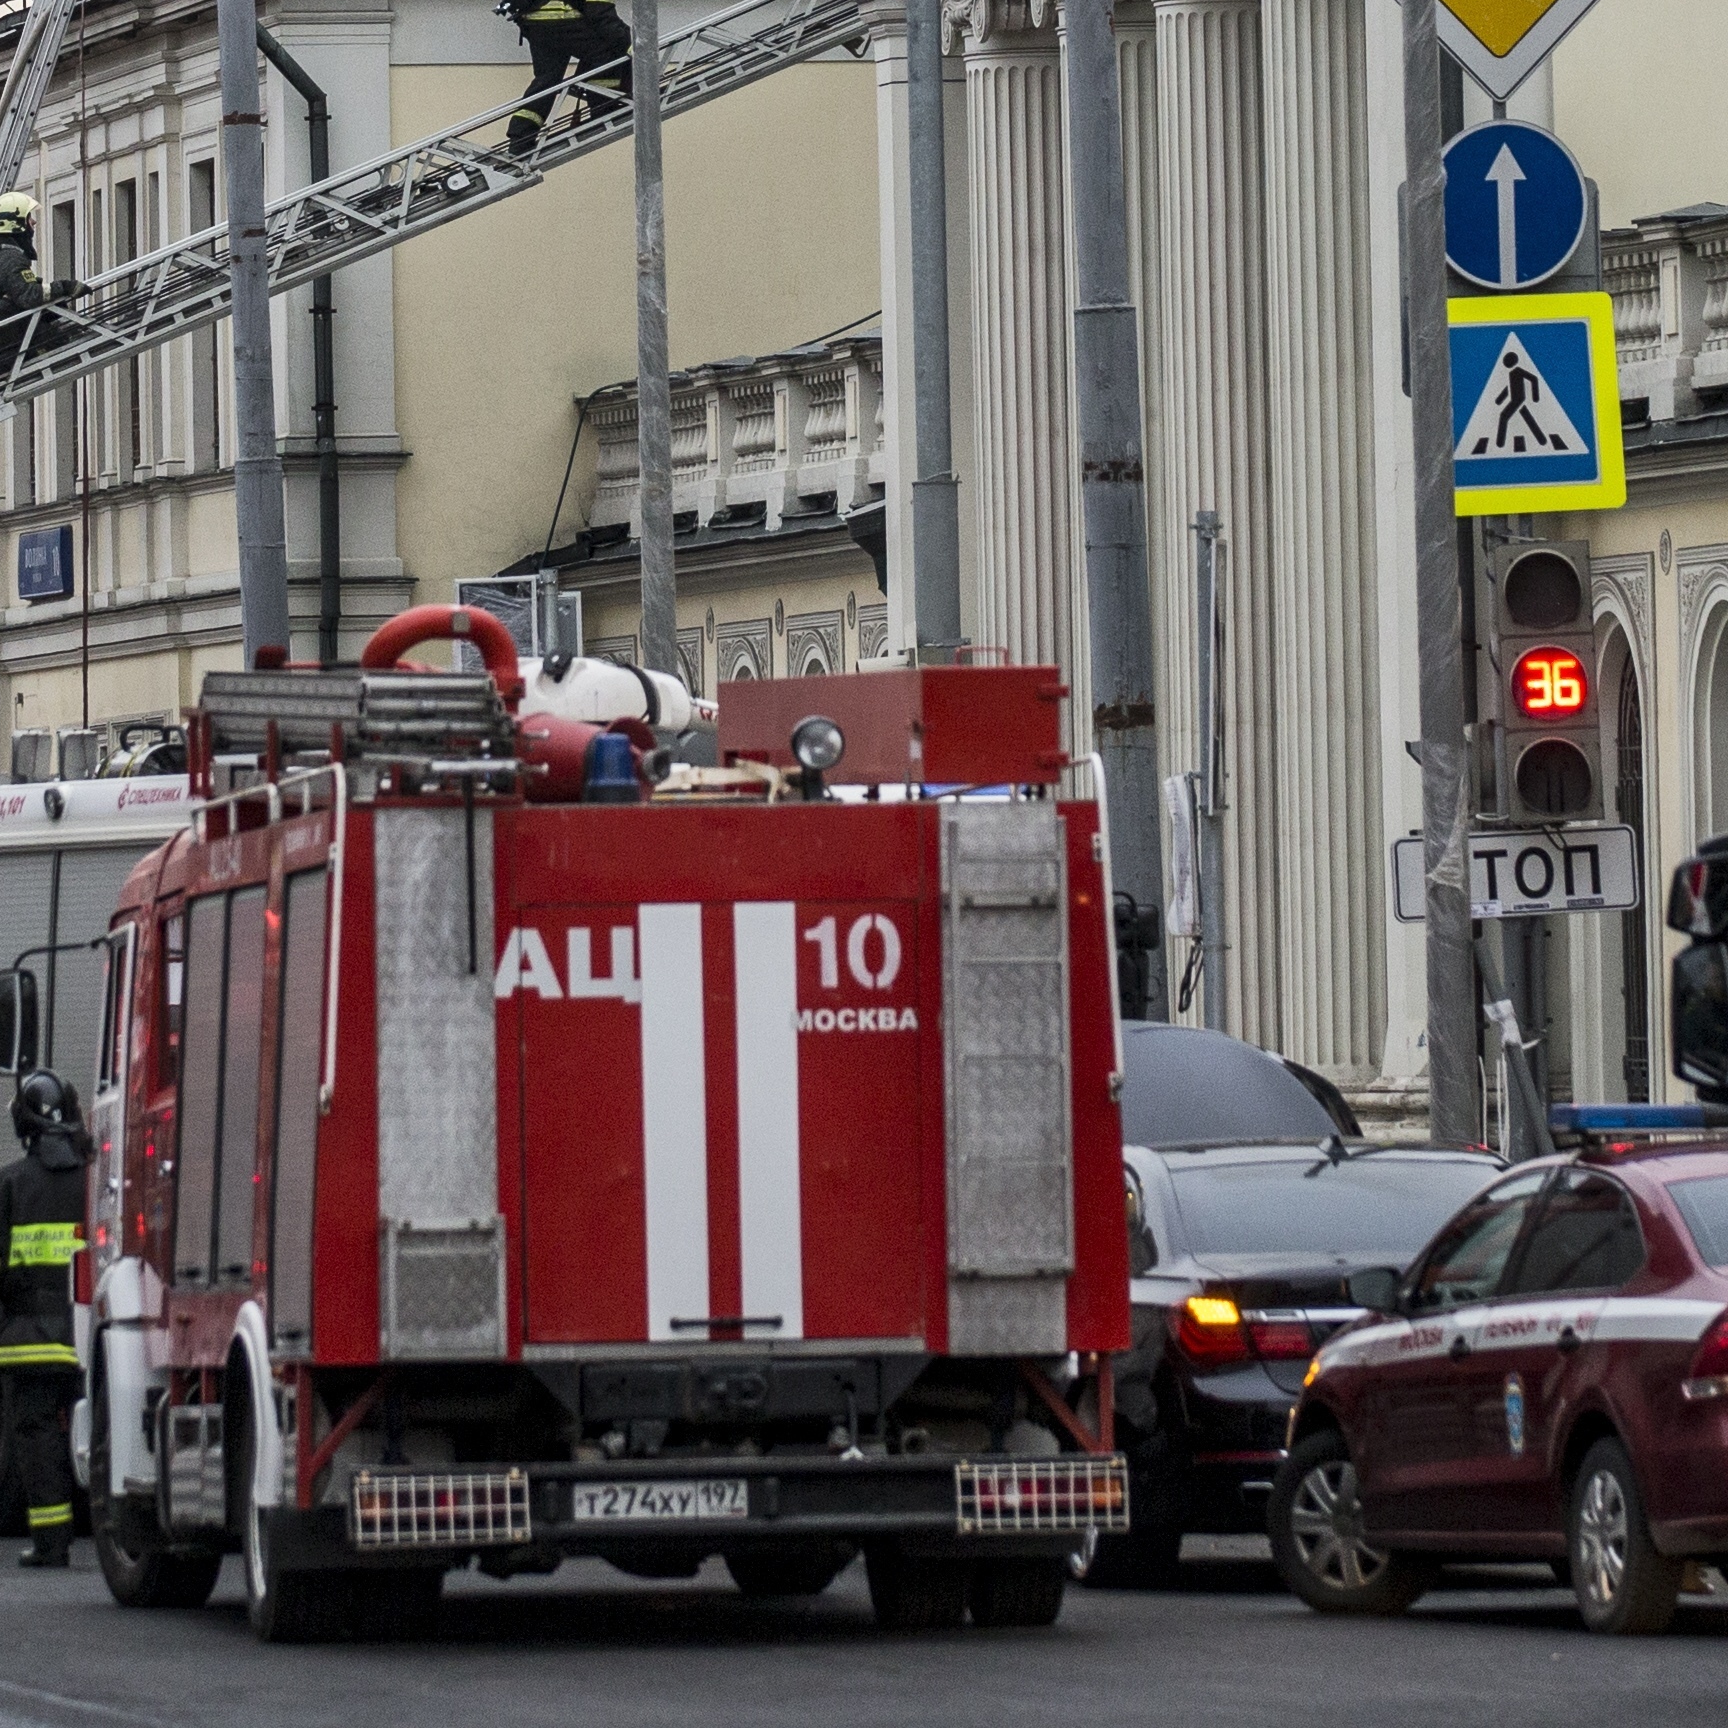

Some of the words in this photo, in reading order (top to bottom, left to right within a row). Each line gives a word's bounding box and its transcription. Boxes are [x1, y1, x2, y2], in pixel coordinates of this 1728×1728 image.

[1527, 659, 1581, 709] 36
[1473, 844, 1602, 900] ТОП
[494, 926, 642, 1004] АЦ
[804, 913, 902, 990] 10
[792, 1007, 919, 1032] МОСКВА
